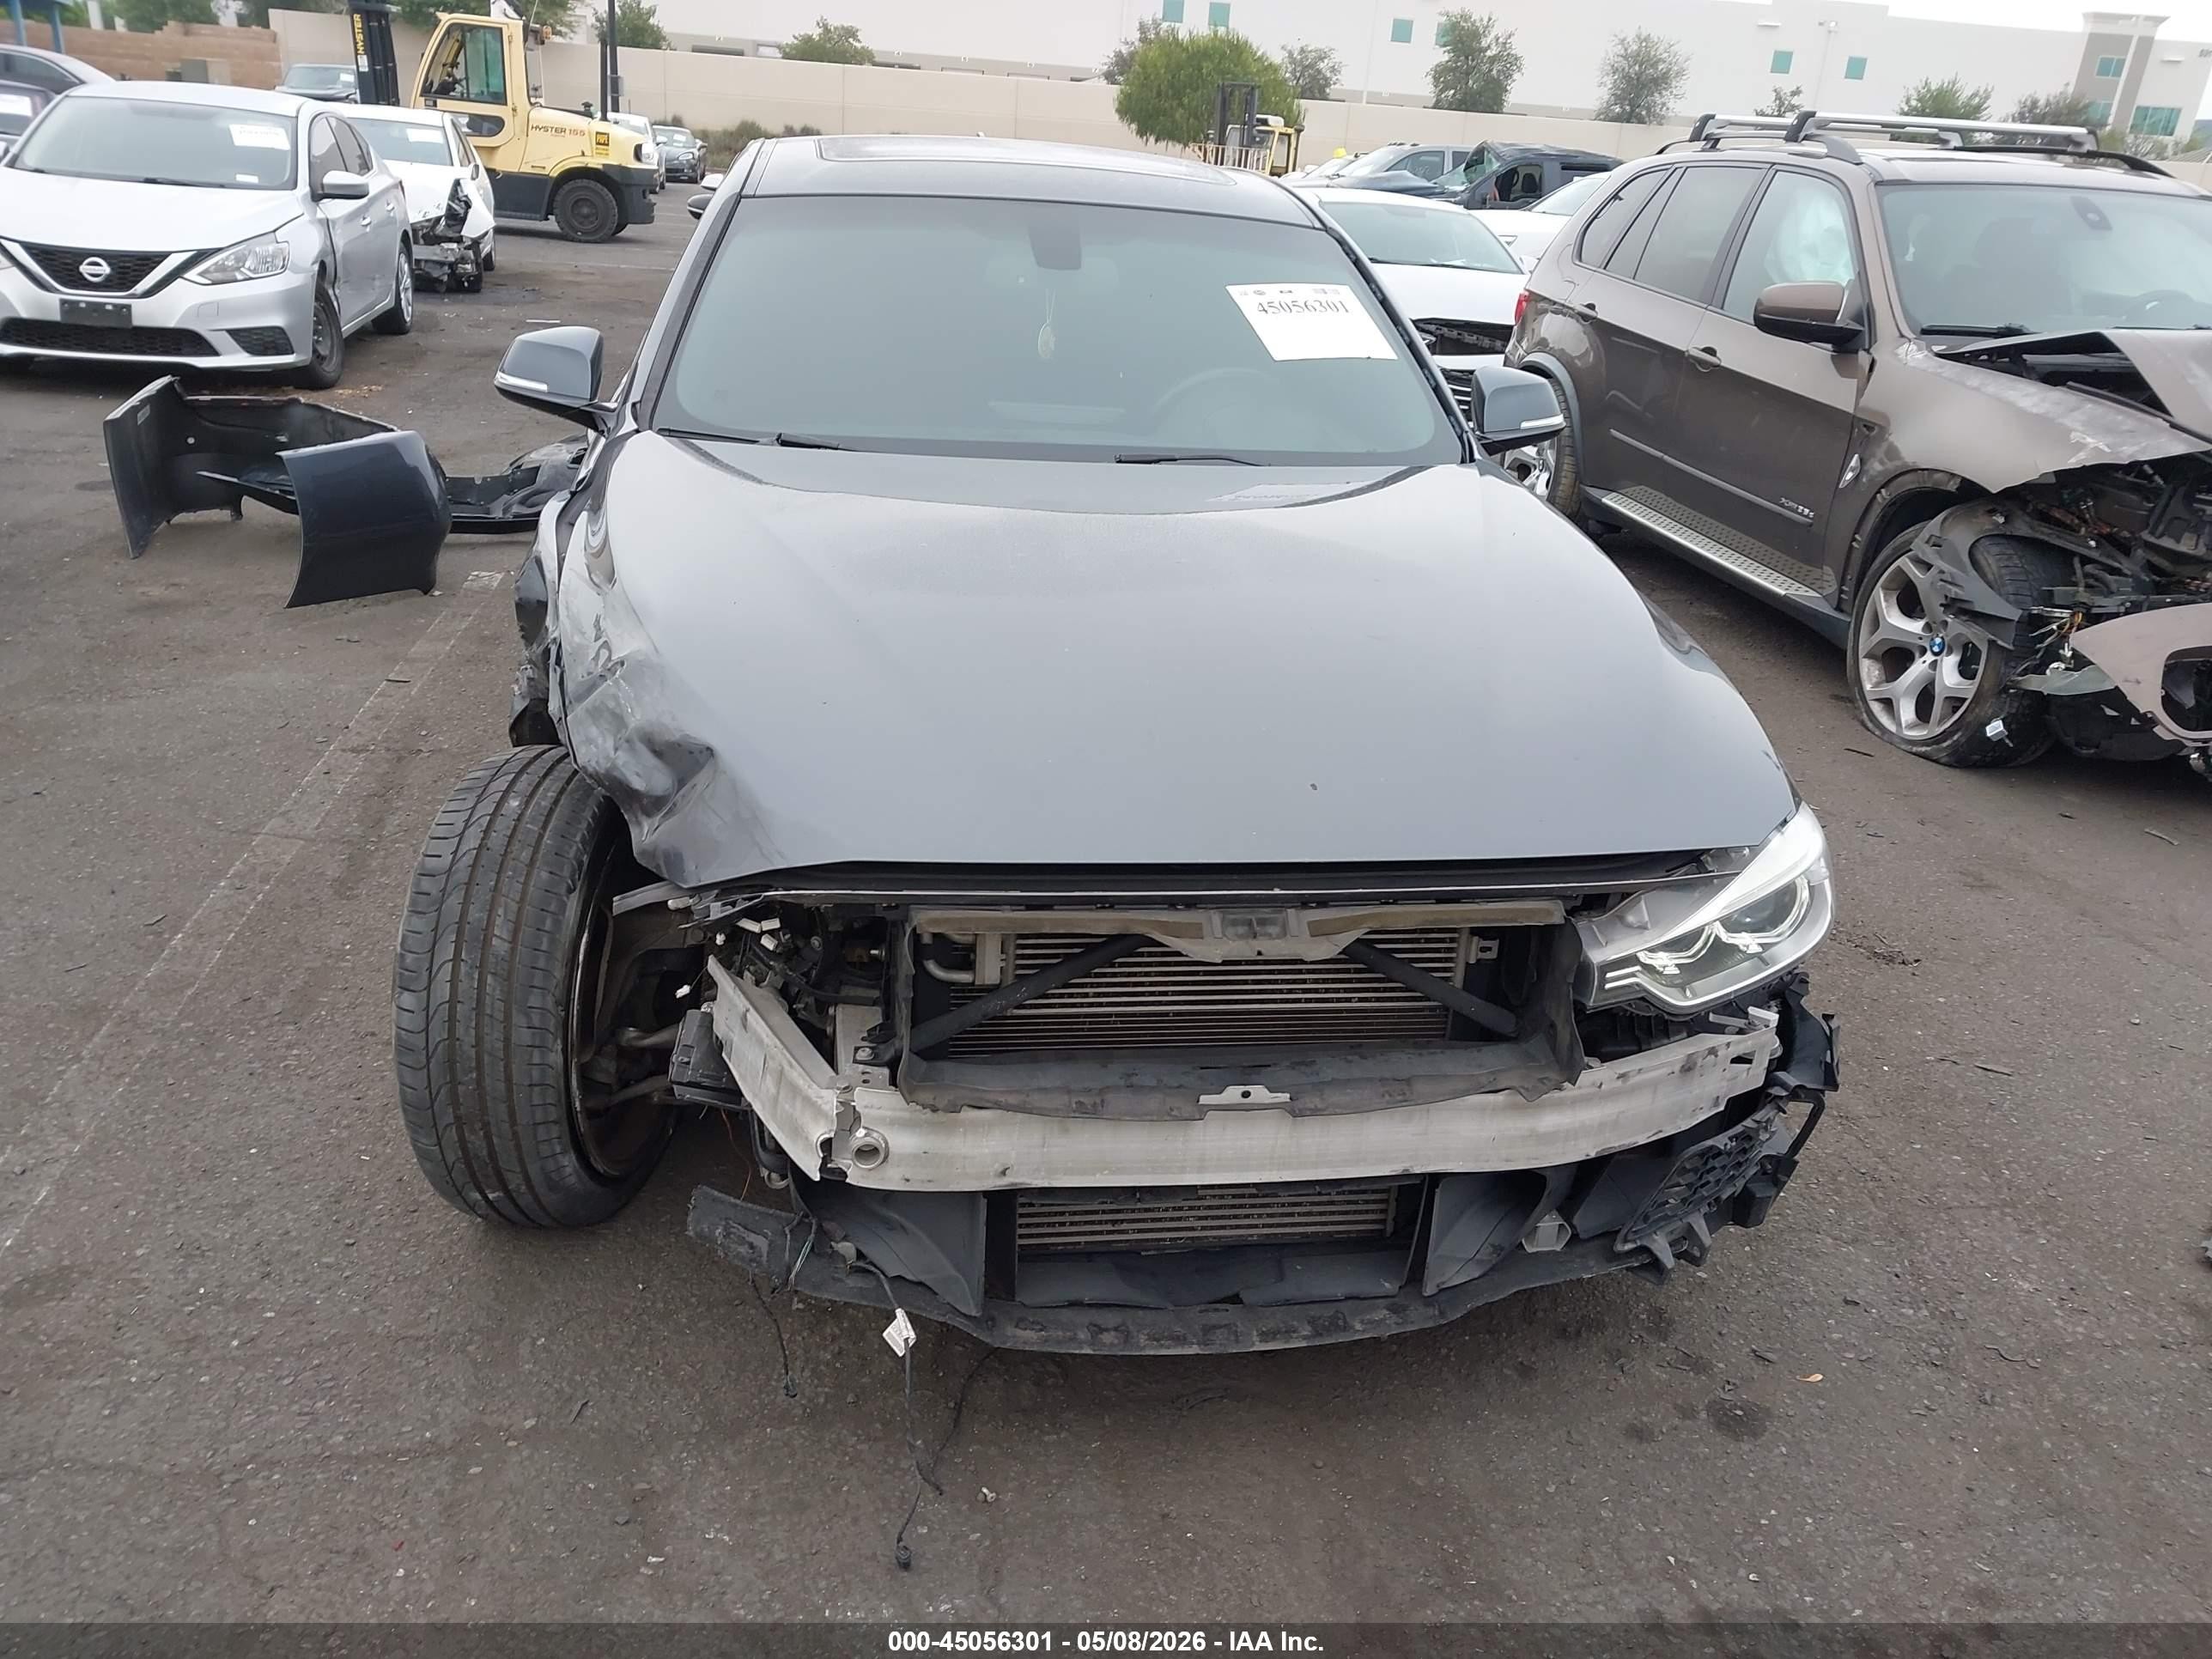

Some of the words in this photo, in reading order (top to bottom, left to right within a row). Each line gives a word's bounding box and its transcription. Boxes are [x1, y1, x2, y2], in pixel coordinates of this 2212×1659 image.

[353, 13, 365, 55] HYSTER
[531, 124, 567, 134] HYSTER
[1257, 300, 1349, 314] 45056301
